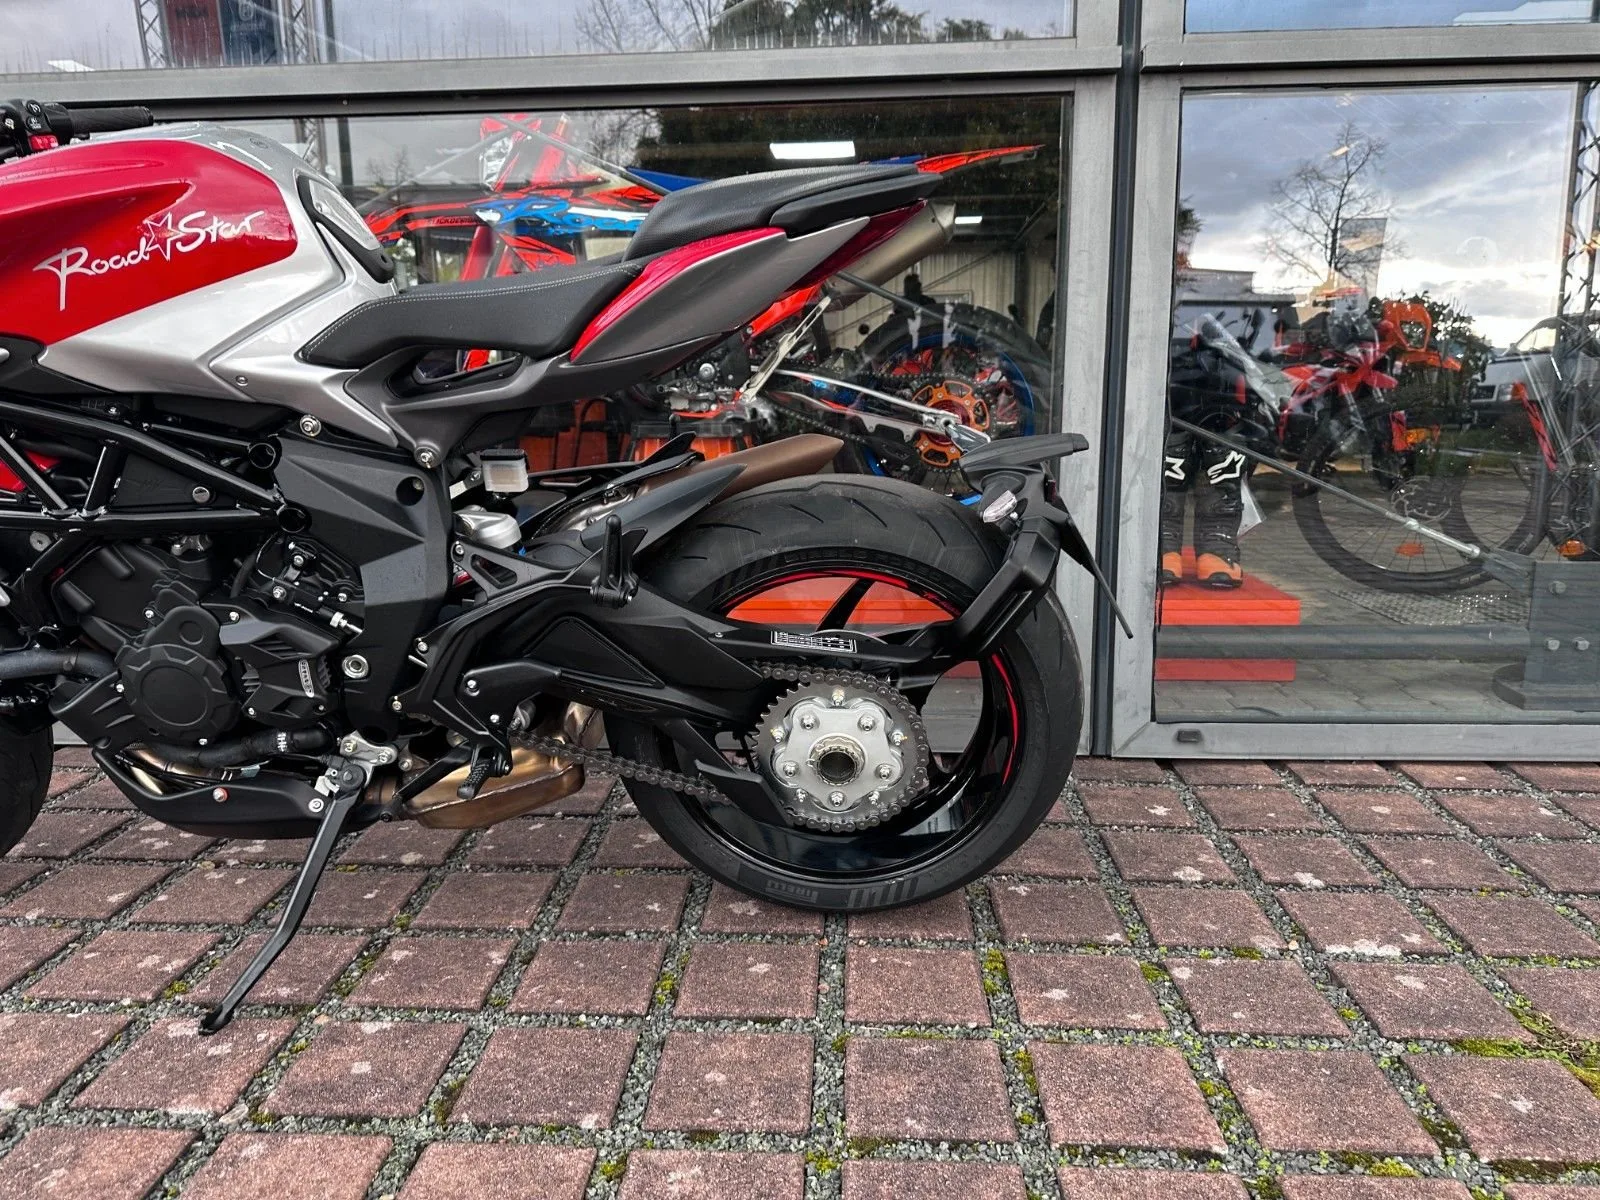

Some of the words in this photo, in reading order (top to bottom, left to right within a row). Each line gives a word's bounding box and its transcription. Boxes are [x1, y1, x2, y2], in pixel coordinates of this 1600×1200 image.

[32, 237, 149, 311] Road
[176, 210, 265, 253] Star
[765, 880, 818, 904] PIRELLI
